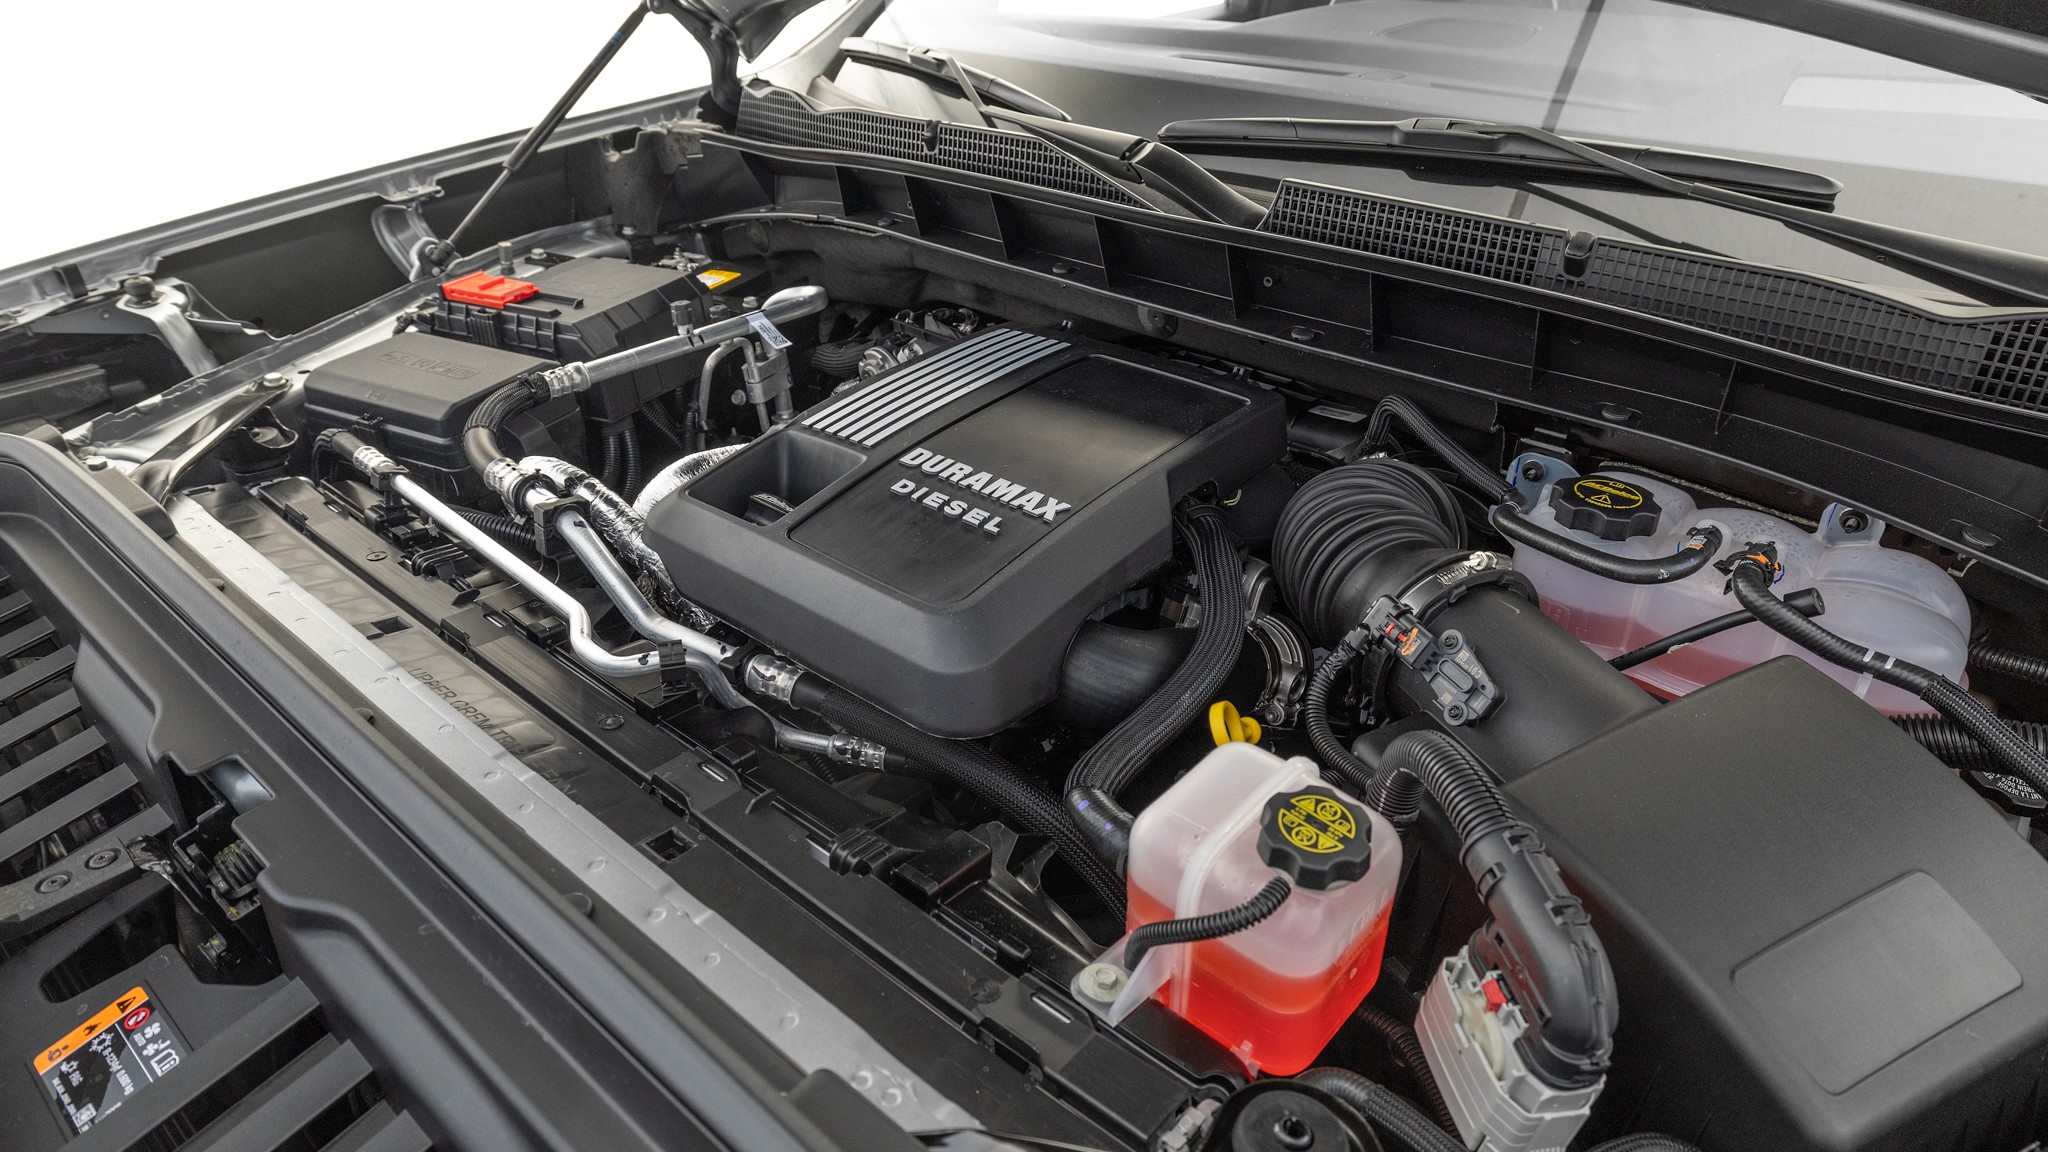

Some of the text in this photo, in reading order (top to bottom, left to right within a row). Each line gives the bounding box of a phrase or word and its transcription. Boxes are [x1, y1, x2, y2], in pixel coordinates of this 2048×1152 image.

[890, 478, 1003, 535] DIESEL
[899, 447, 1072, 523] DURAMAX
[409, 667, 457, 702] UPPER
